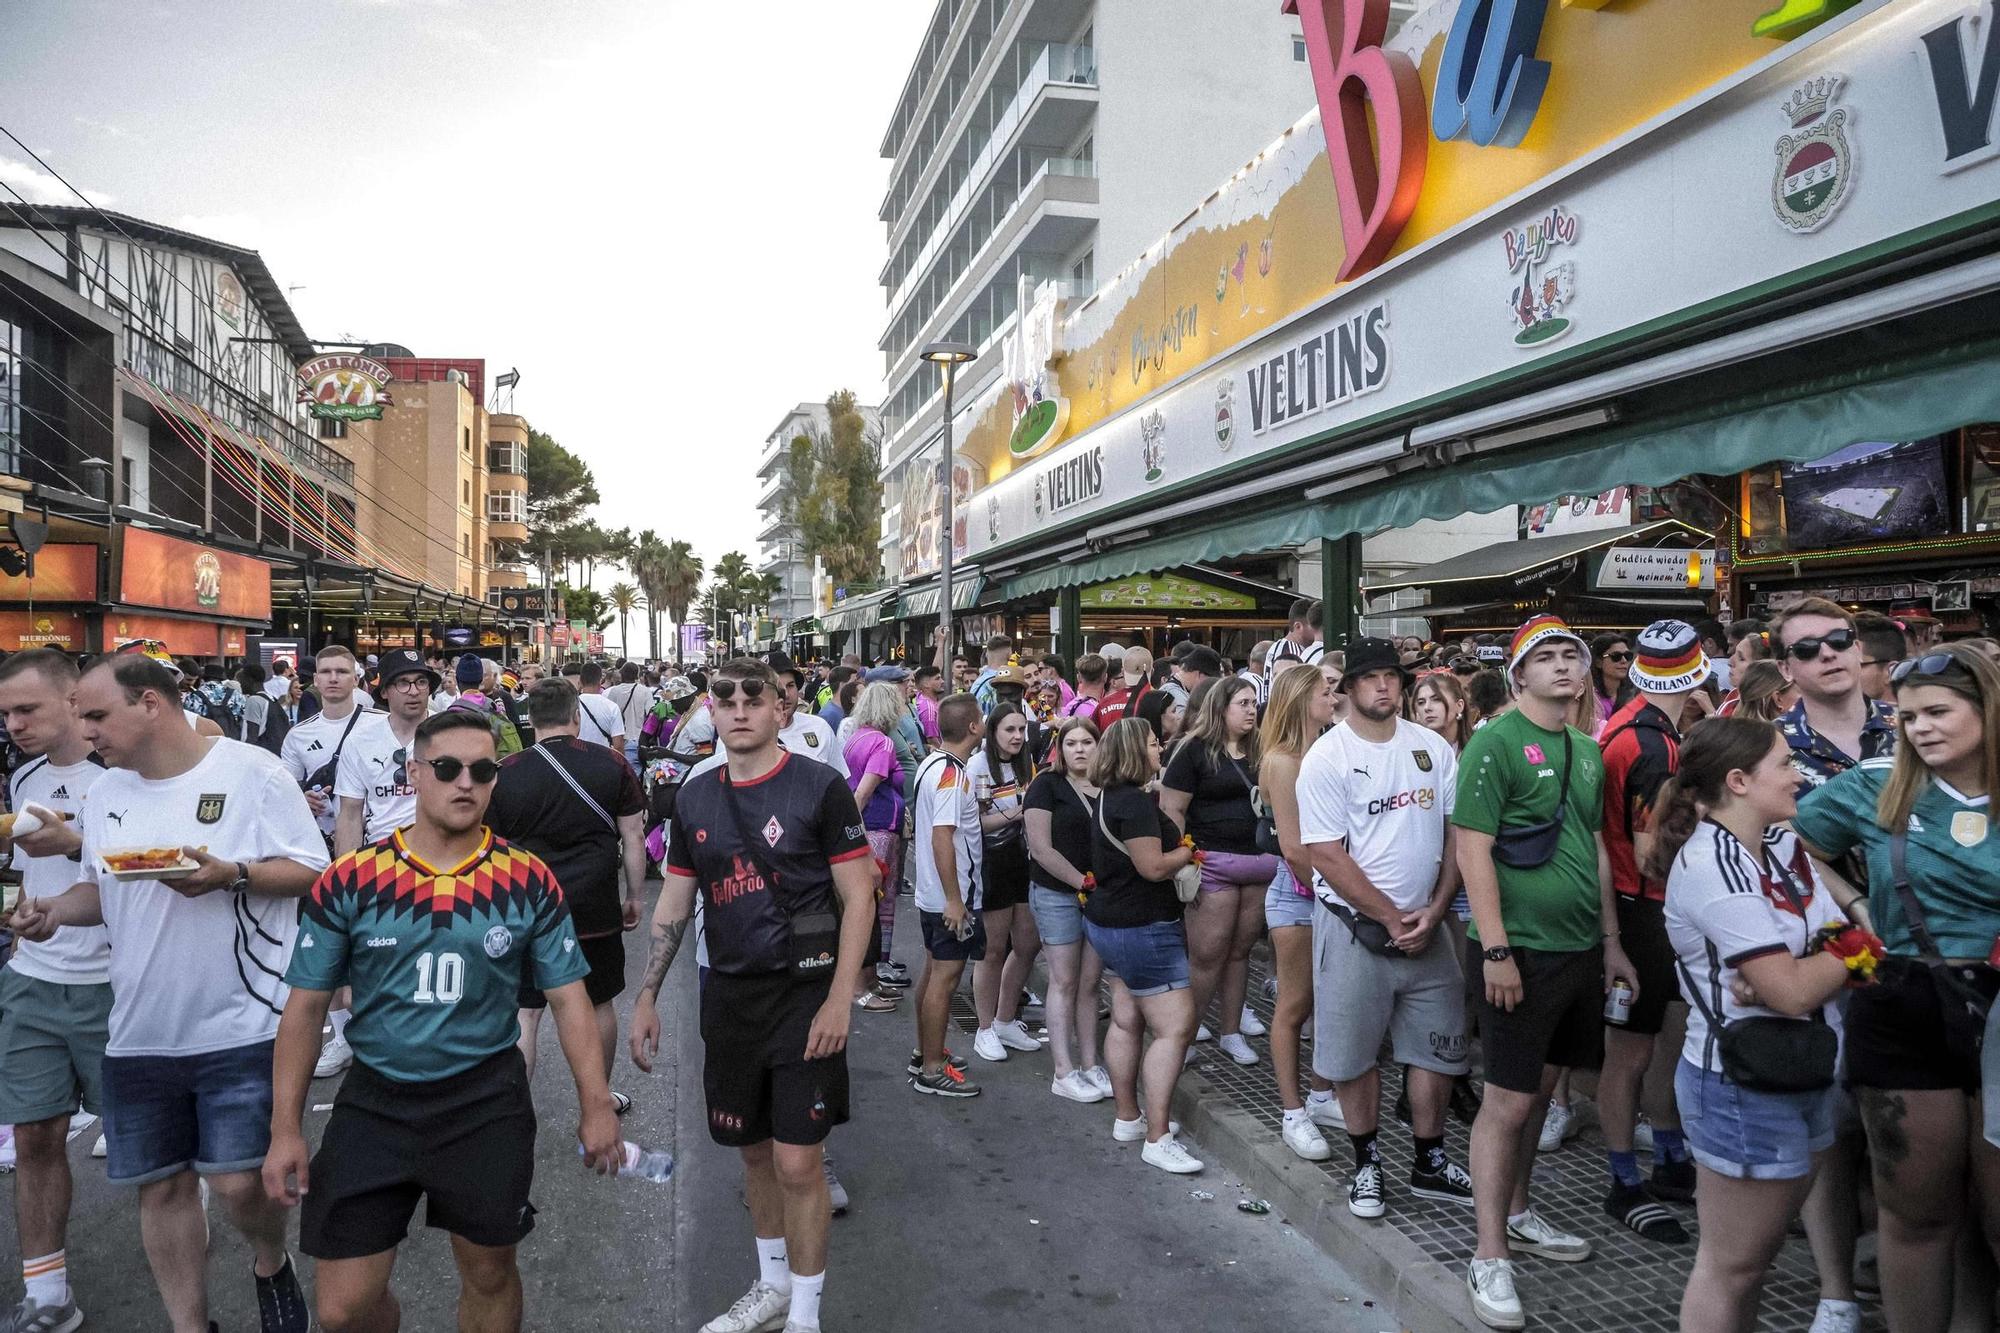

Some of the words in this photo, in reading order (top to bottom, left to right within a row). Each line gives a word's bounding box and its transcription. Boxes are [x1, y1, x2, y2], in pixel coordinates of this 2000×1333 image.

[1502, 208, 1575, 270] Bamboleo
[302, 357, 387, 382] BIERKÖNIG
[1247, 304, 1387, 432] VELTINS
[1048, 446, 1102, 511] VELTINS
[1615, 554, 1653, 564] Endlich
[1656, 556, 1687, 565] wieder
[19, 634, 71, 642] BIERKÖNIG
[1629, 666, 1692, 691] DEUTSCHLAND
[367, 937, 397, 947] adidas
[413, 952, 465, 1003] 10
